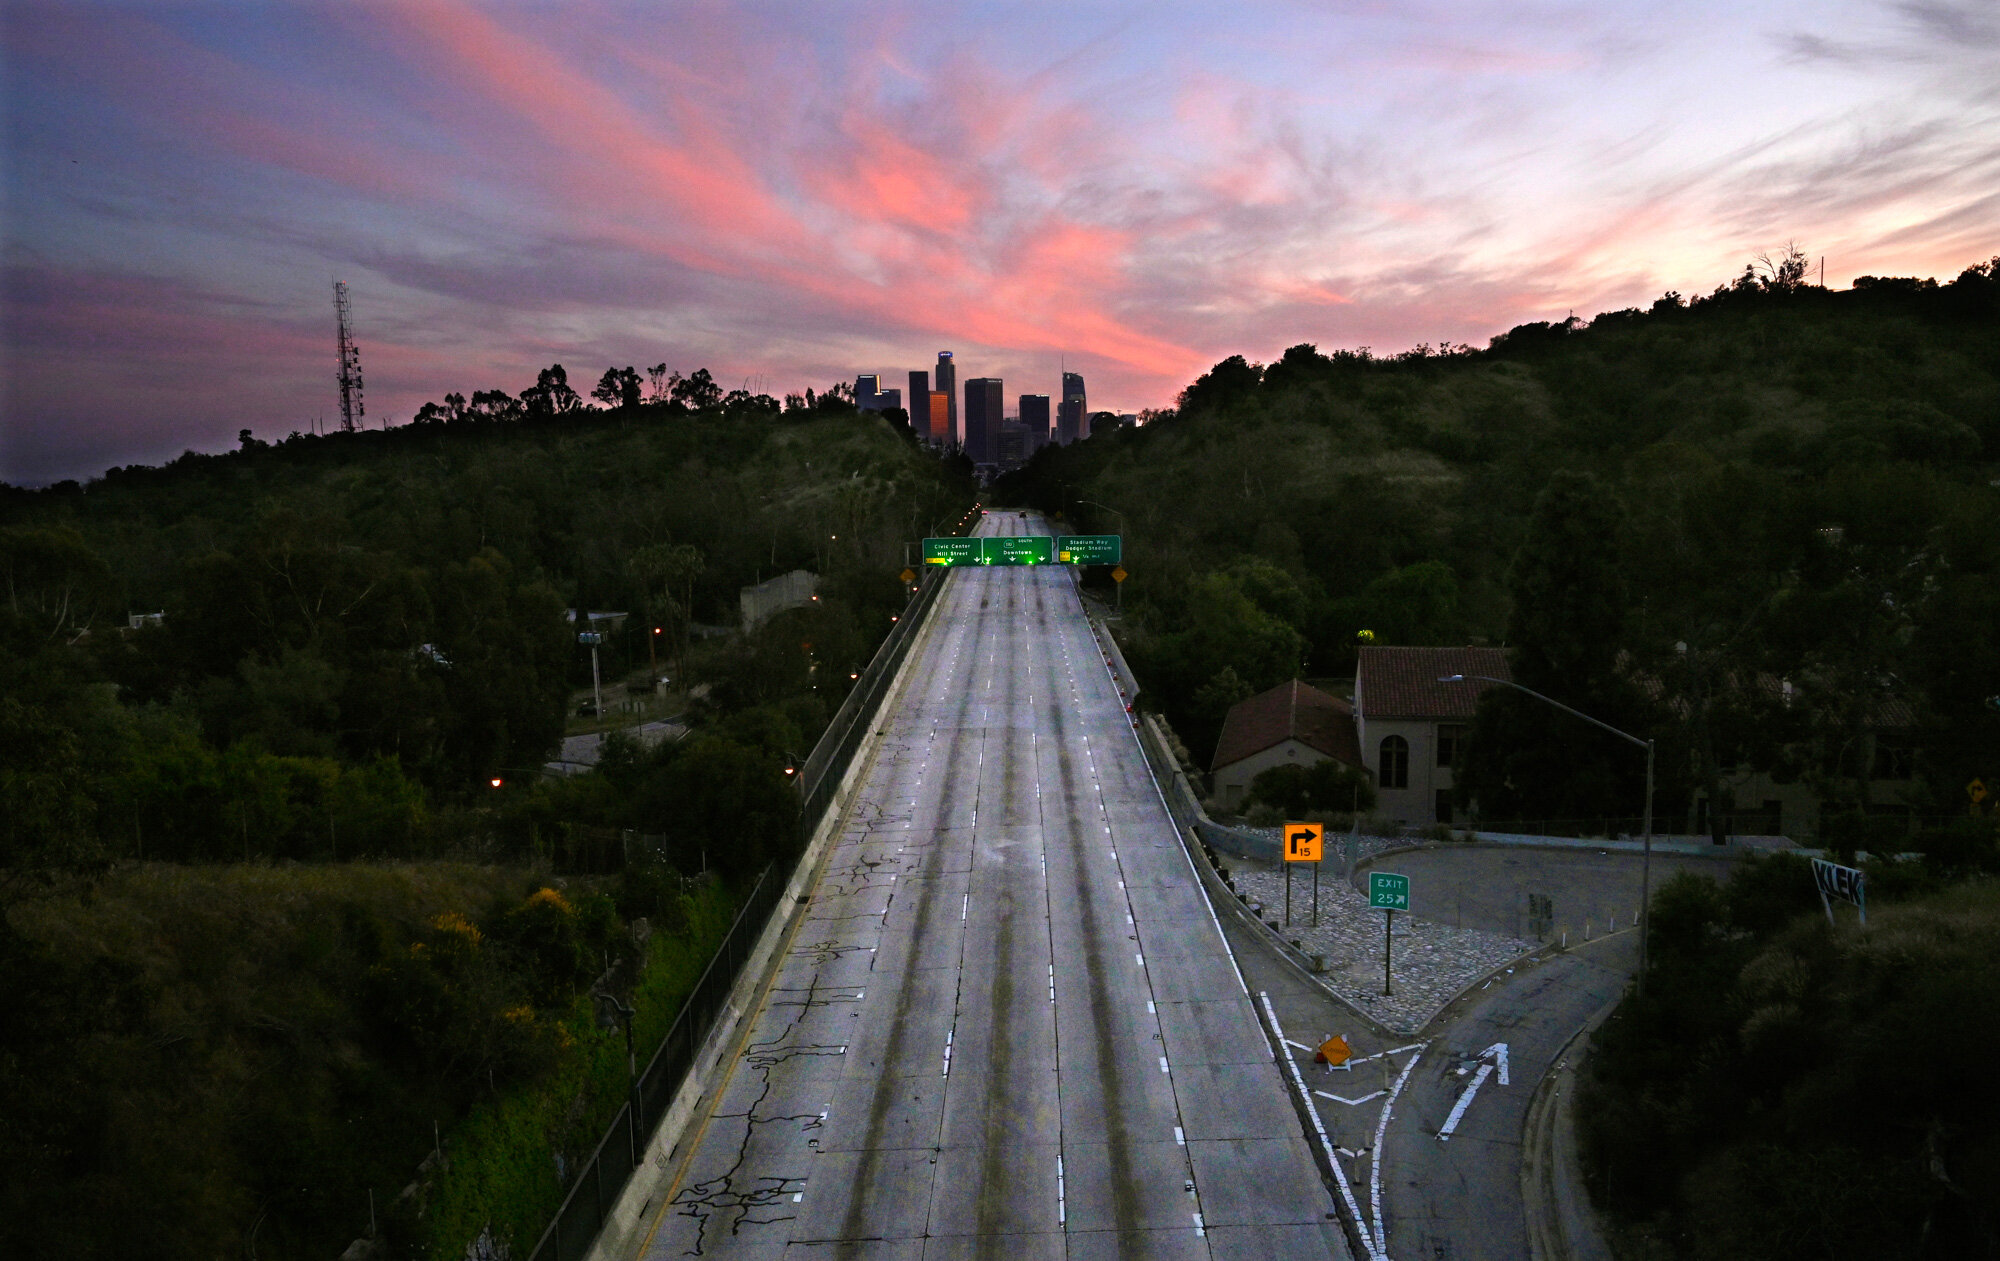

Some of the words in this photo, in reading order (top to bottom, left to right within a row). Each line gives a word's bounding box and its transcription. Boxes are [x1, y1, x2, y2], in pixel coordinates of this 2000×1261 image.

[1299, 848, 1311, 857] 15
[1378, 879, 1403, 889] EXIT
[1378, 893, 1394, 904] 25
